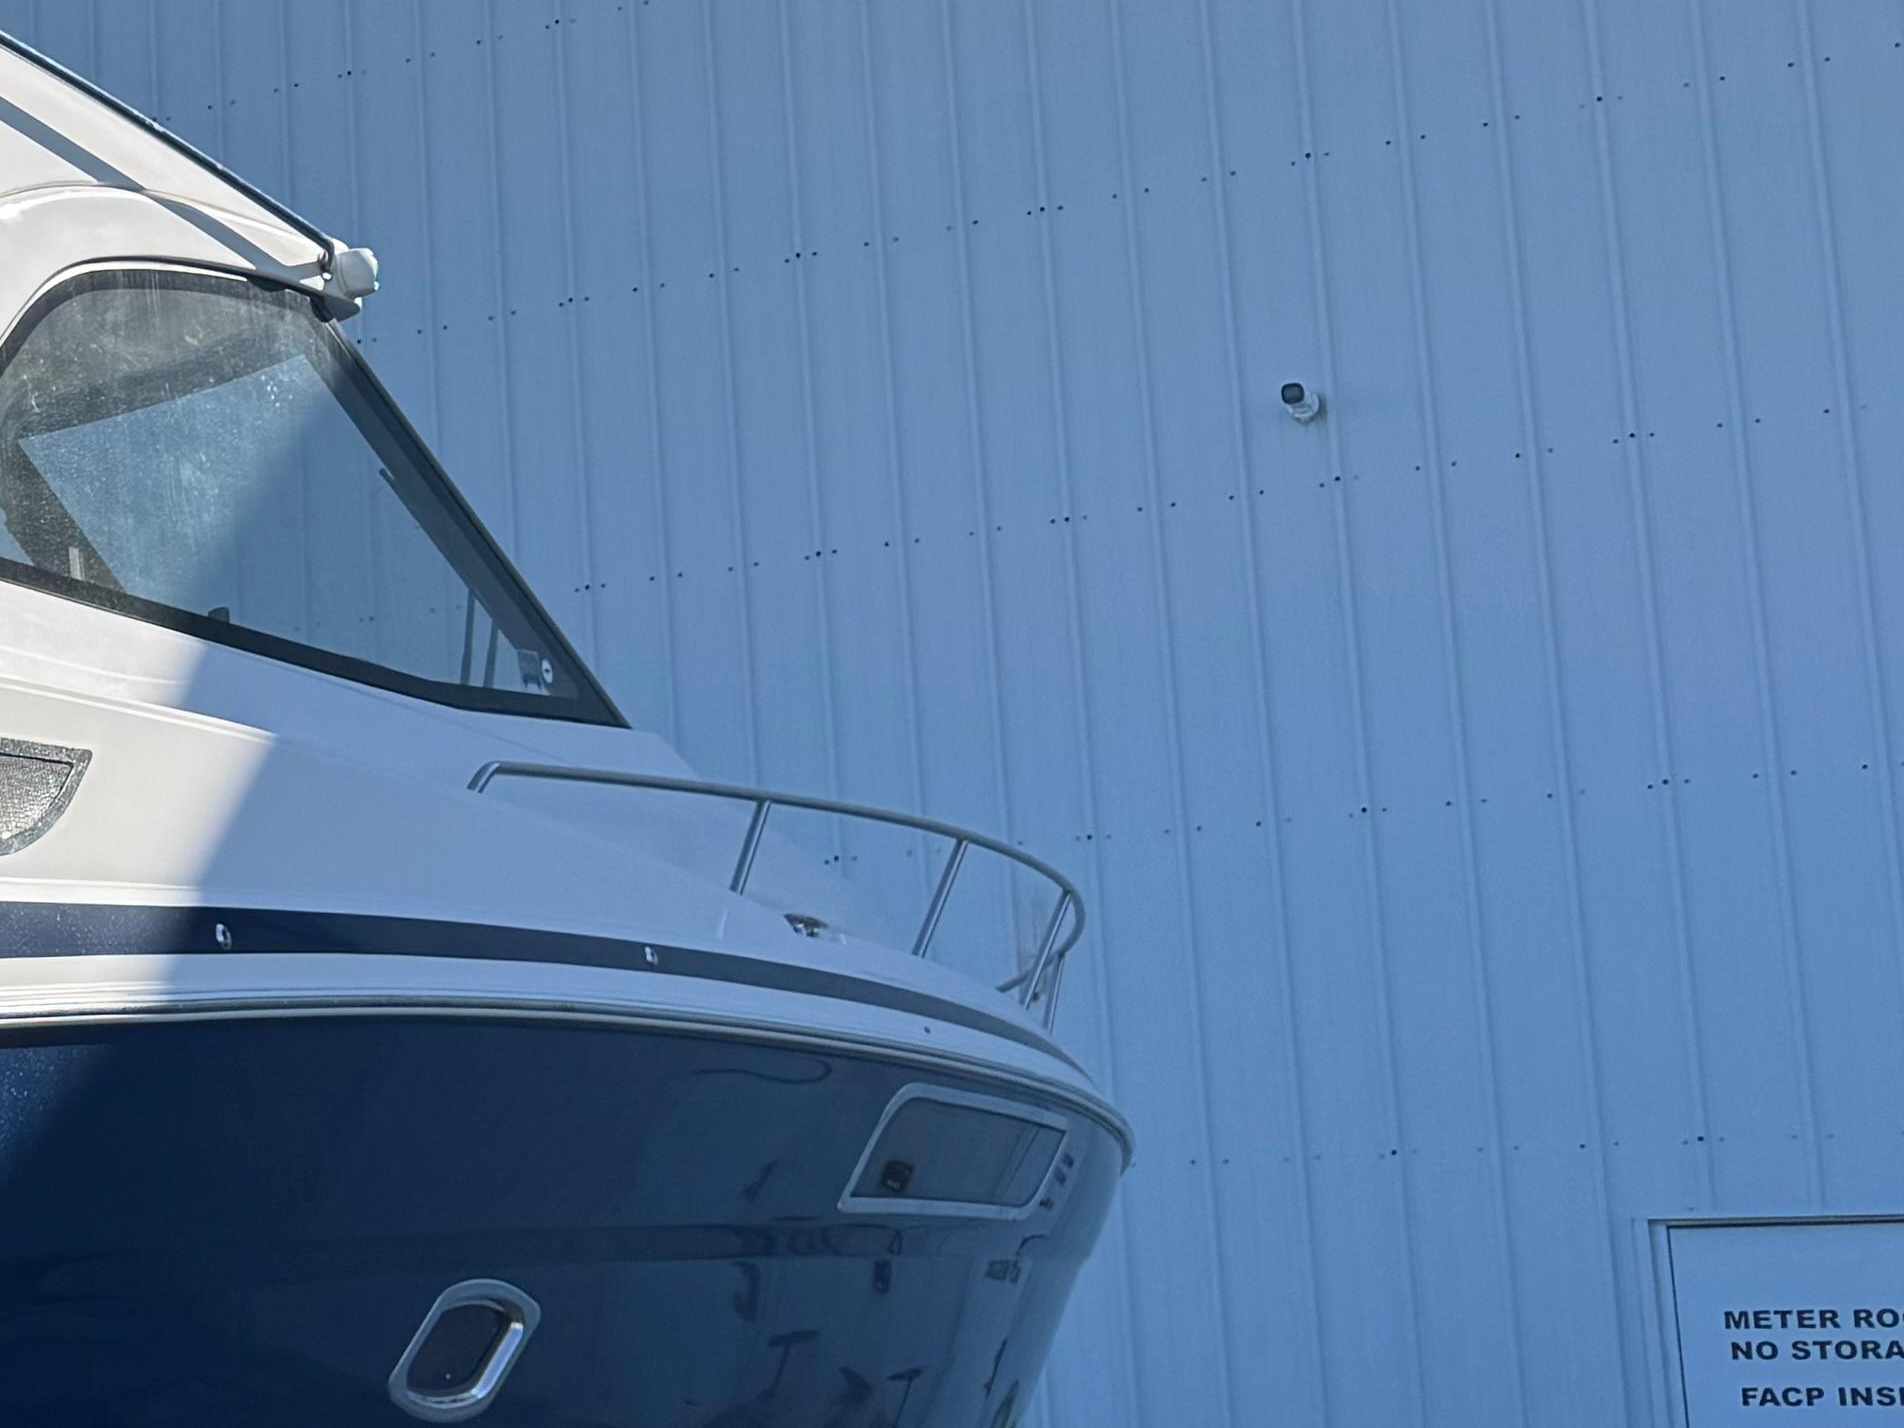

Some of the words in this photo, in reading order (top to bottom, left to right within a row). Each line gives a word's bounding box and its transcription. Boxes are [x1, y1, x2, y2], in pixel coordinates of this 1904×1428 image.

[1724, 1309, 1841, 1330] METER
[1853, 1308, 1904, 1329] RO
[1731, 1341, 1779, 1360] NO
[1791, 1340, 1904, 1360] STORA
[1741, 1387, 1825, 1407] FACP
